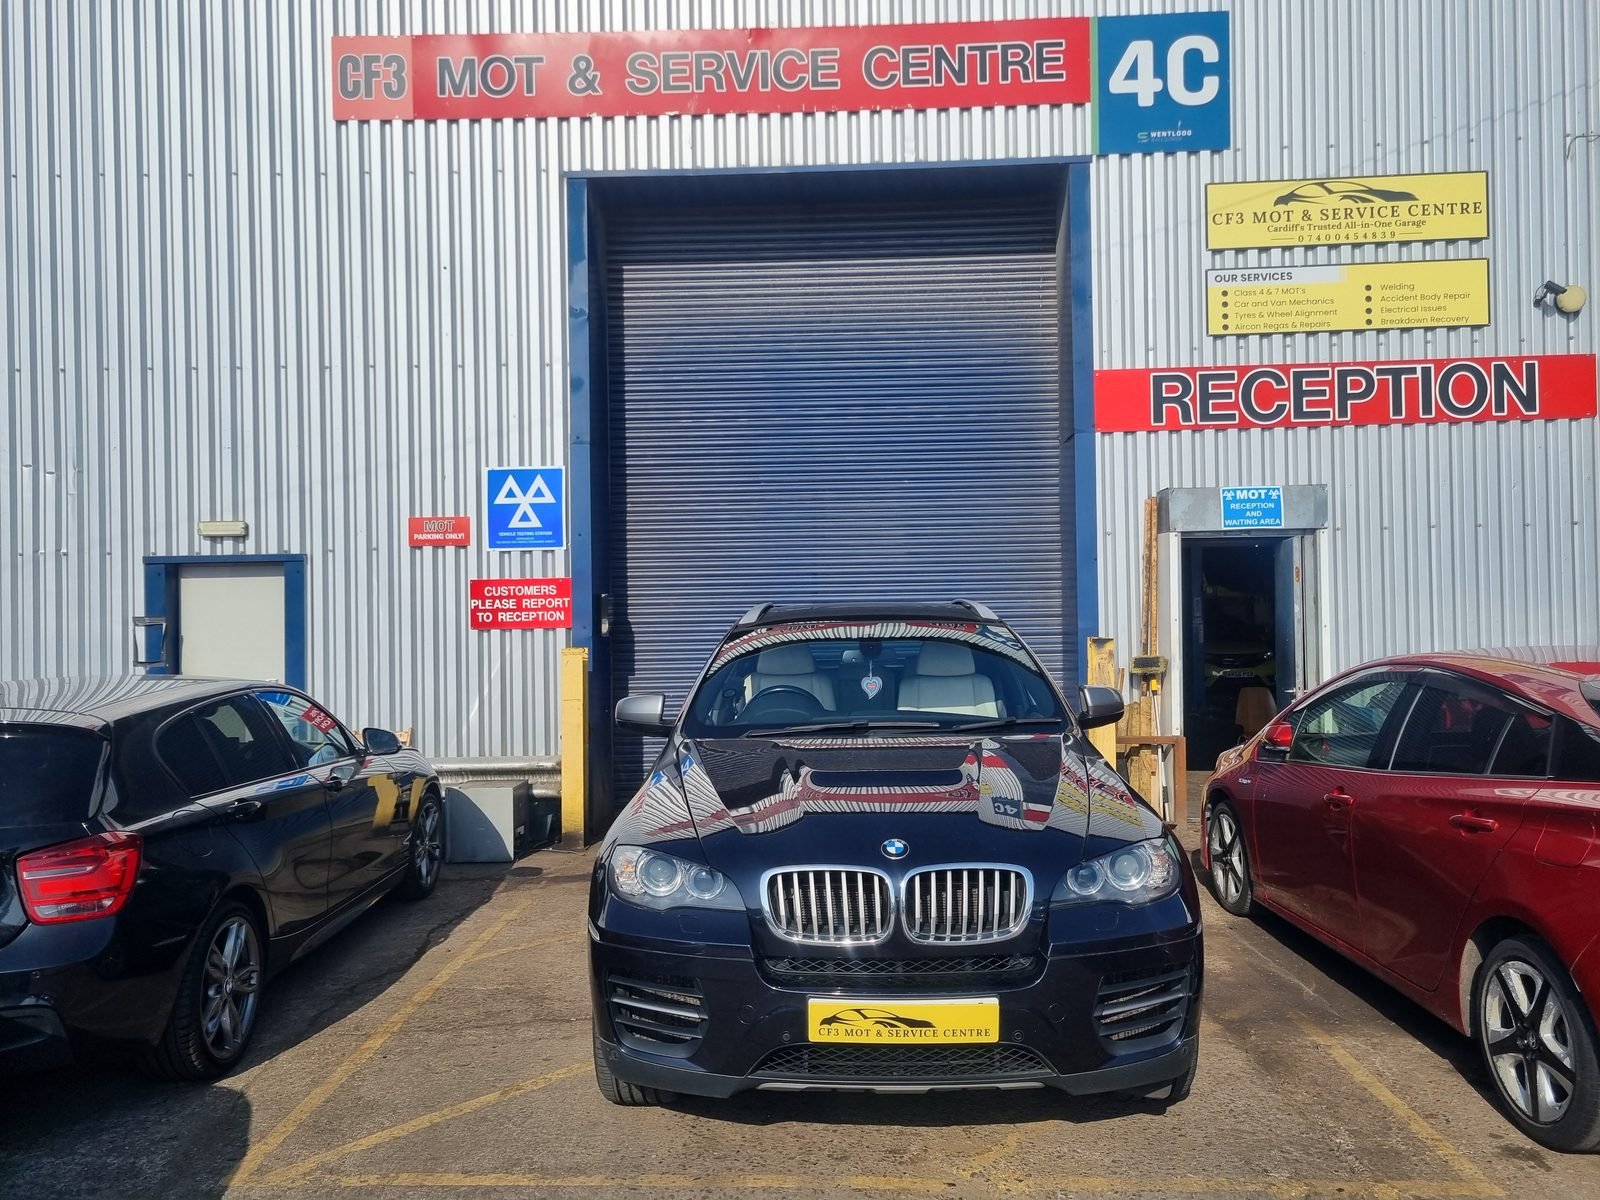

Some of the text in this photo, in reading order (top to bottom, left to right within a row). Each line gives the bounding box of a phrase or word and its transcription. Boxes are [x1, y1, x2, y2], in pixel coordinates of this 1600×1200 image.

[338, 39, 1066, 101] CF3 MOT & SERVICE CENTRE
[1108, 35, 1220, 107] 4C
[1211, 201, 1483, 226] CF3 MOT & SERVICE CENTRE
[1266, 218, 1427, 233] Cardiff's Trusted All-in-One Garage
[1214, 271, 1293, 283] OUR SERVICES
[1233, 287, 1306, 297] Class 4 & 7 MOT's
[1380, 282, 1415, 292] Welding
[1233, 297, 1335, 309] Car and Van Mechanics
[1380, 292, 1471, 303] Accident Body Repair
[1380, 304, 1447, 314] Electrical Issues
[1235, 309, 1338, 321] Tyres & Wheel Alignment
[1380, 315, 1470, 326] Breakdown Recovery
[1234, 320, 1331, 331] Aircon Regas & Repairs
[1149, 361, 1540, 426] RECEPTION
[1235, 489, 1267, 500] MOT
[1230, 502, 1275, 510] RECEPTION
[423, 519, 456, 533] MOT
[1224, 518, 1258, 526] WAITING
[413, 532, 465, 540] PARKING ONLY!
[484, 585, 557, 596] CUSTOMERS
[470, 597, 571, 610] PLEASE REPORT
[476, 610, 565, 623] TO RECEPTION
[818, 1027, 991, 1038] CF3 MOT & SERVICE CENTRE
